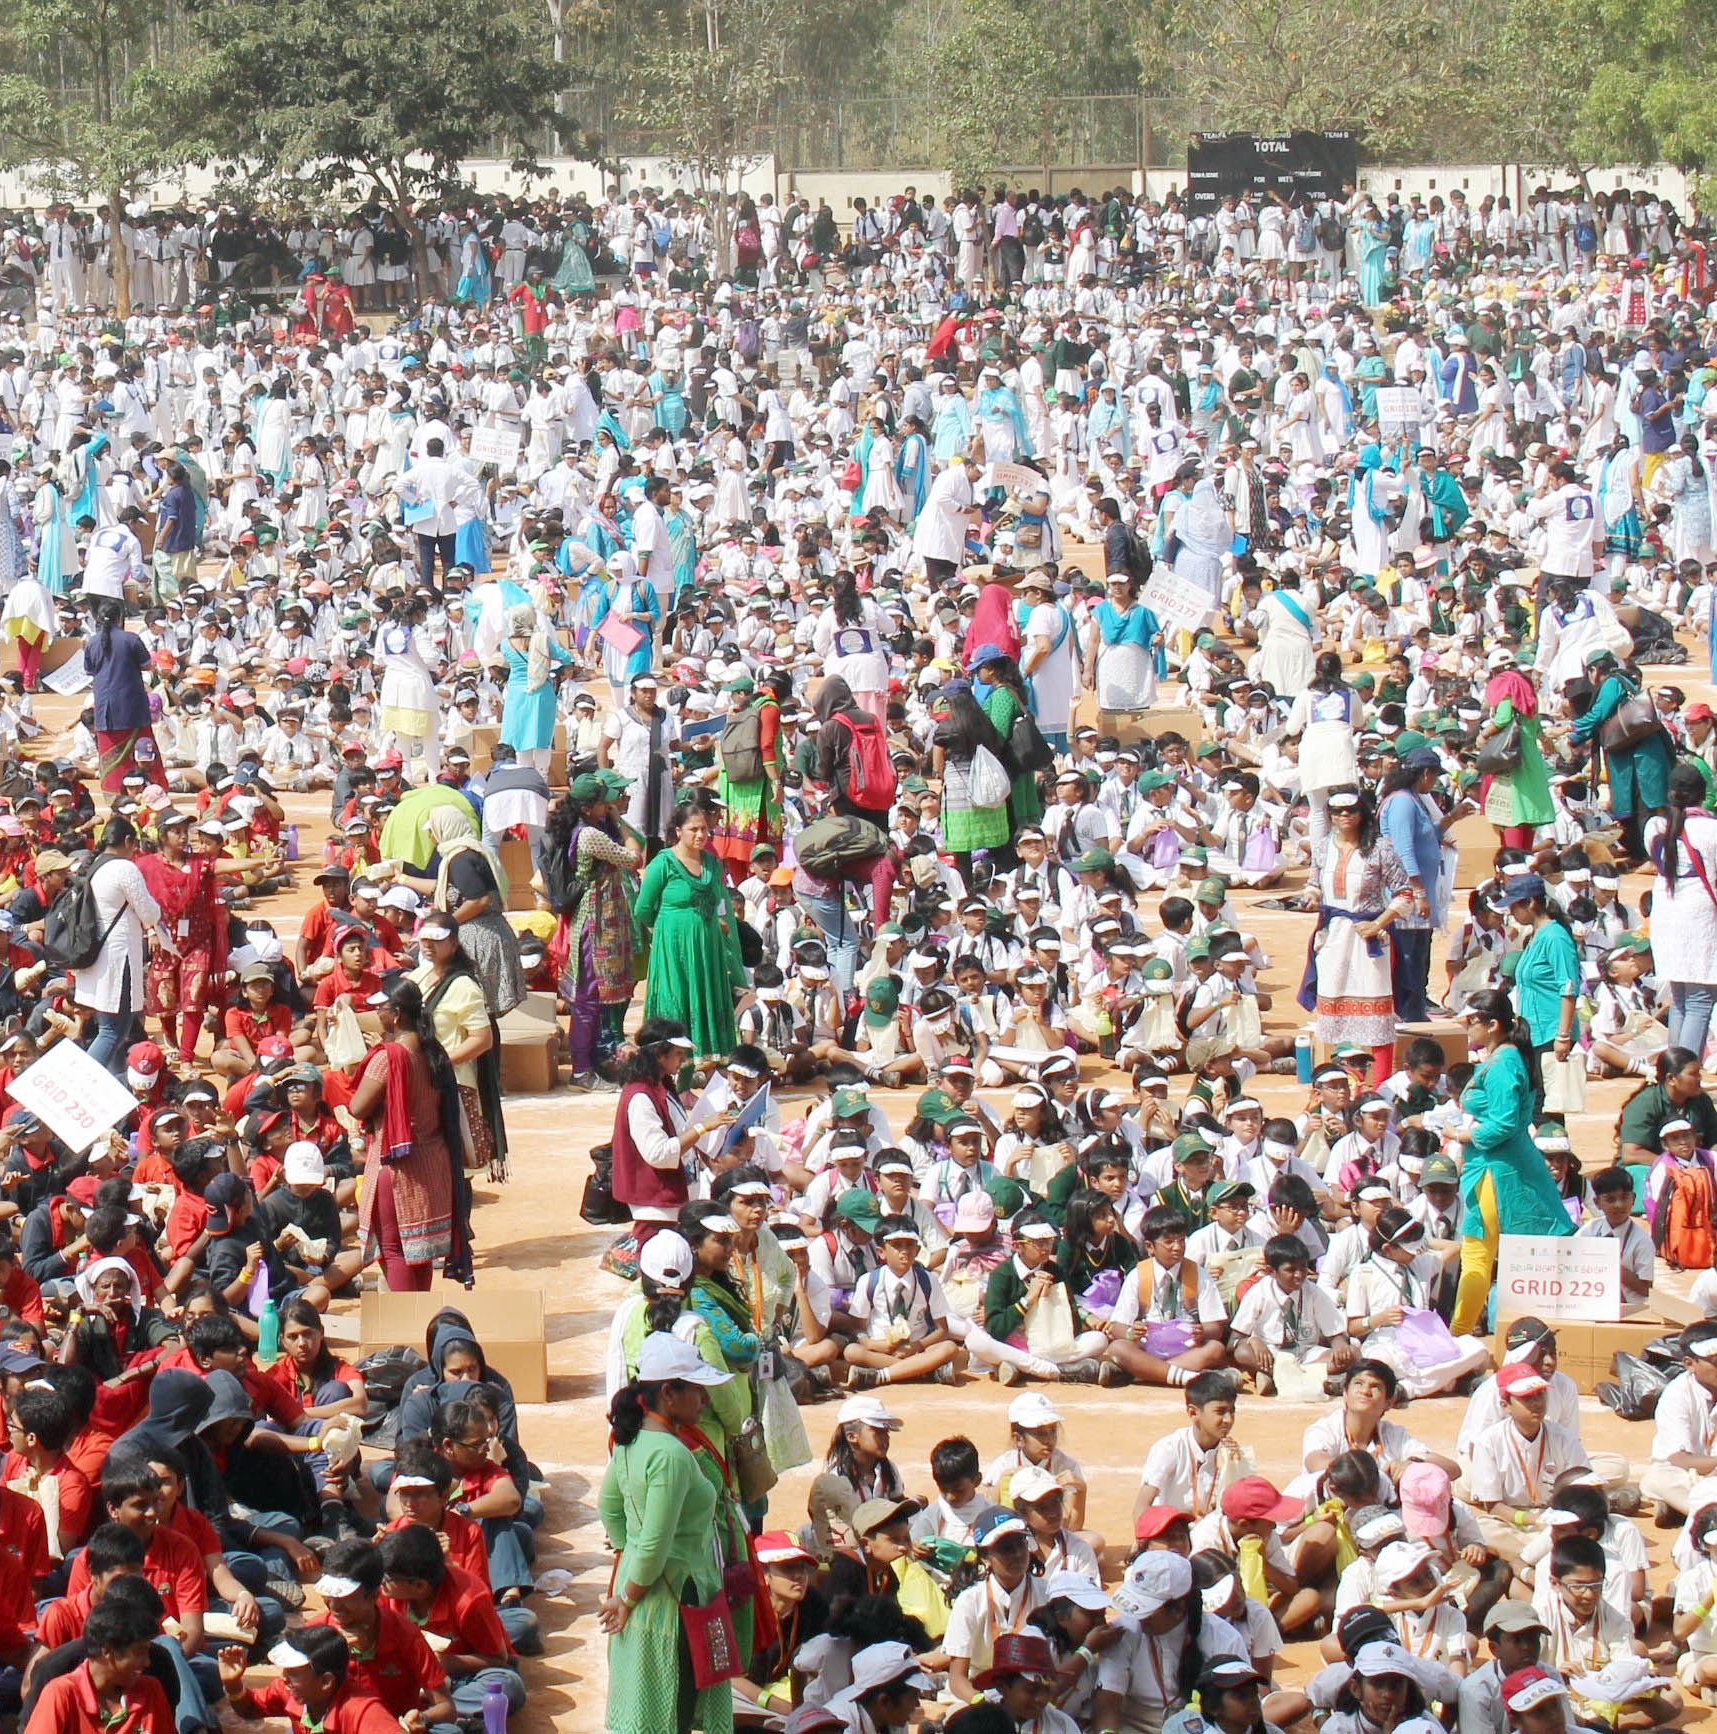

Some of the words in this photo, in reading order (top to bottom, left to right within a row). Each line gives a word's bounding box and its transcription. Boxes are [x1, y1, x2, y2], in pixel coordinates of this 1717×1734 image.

[1254, 141, 1290, 153] TOTAL
[1253, 176, 1266, 184] FOR
[1150, 590, 1176, 608] GRID
[32, 1074, 68, 1103] GRID
[65, 1100, 96, 1129] 230
[1510, 1279, 1563, 1296] GRID
[1569, 1280, 1606, 1297] 229
